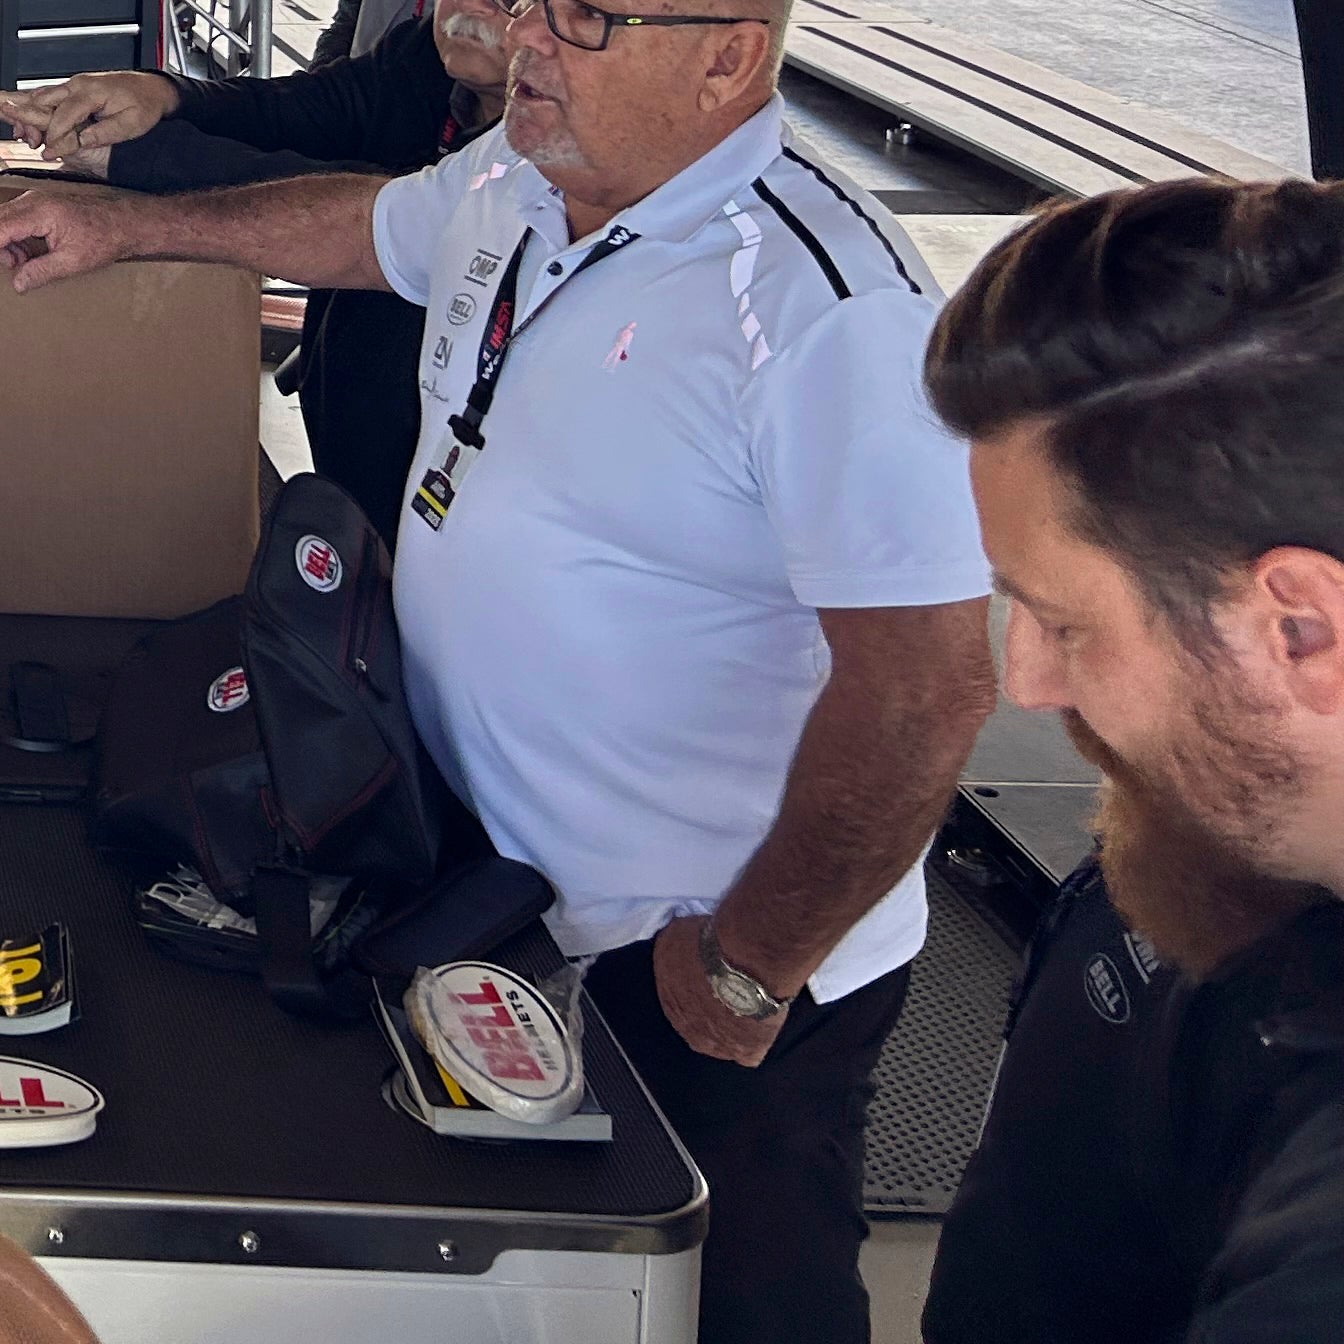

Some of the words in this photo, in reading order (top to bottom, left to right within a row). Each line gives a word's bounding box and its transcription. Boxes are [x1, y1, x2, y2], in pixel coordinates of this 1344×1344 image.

[489, 301, 512, 349] IMSA
[1089, 959, 1121, 1013] BELL
[448, 982, 546, 1081] BELL
